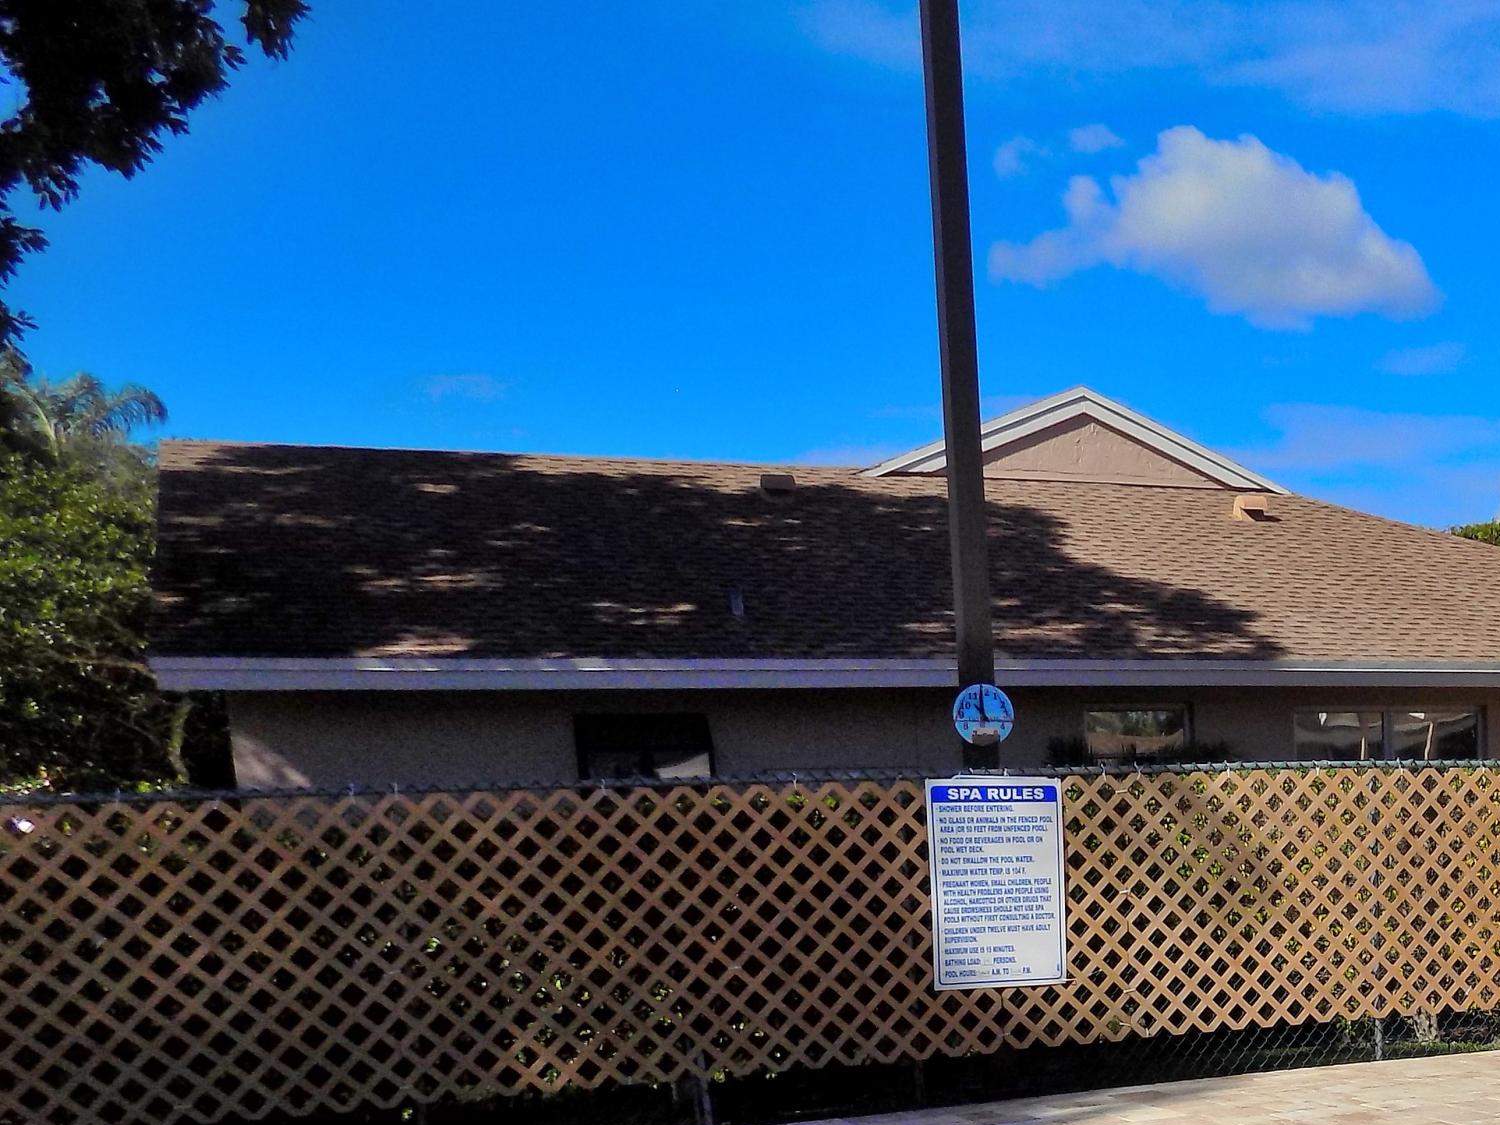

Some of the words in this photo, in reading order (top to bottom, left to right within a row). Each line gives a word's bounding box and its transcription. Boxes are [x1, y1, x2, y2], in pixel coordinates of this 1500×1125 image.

[961, 701, 971, 710] 10
[947, 788, 981, 800] SPA
[987, 788, 1045, 800] RULES
[974, 836, 1004, 844] BEVERAGES
[942, 868, 968, 876] MAXIMUM
[969, 897, 996, 905] NARCOTICS
[961, 915, 983, 923] WITHOUT
[987, 925, 1006, 933] TWELVE
[945, 947, 968, 955] MAXIMUM
